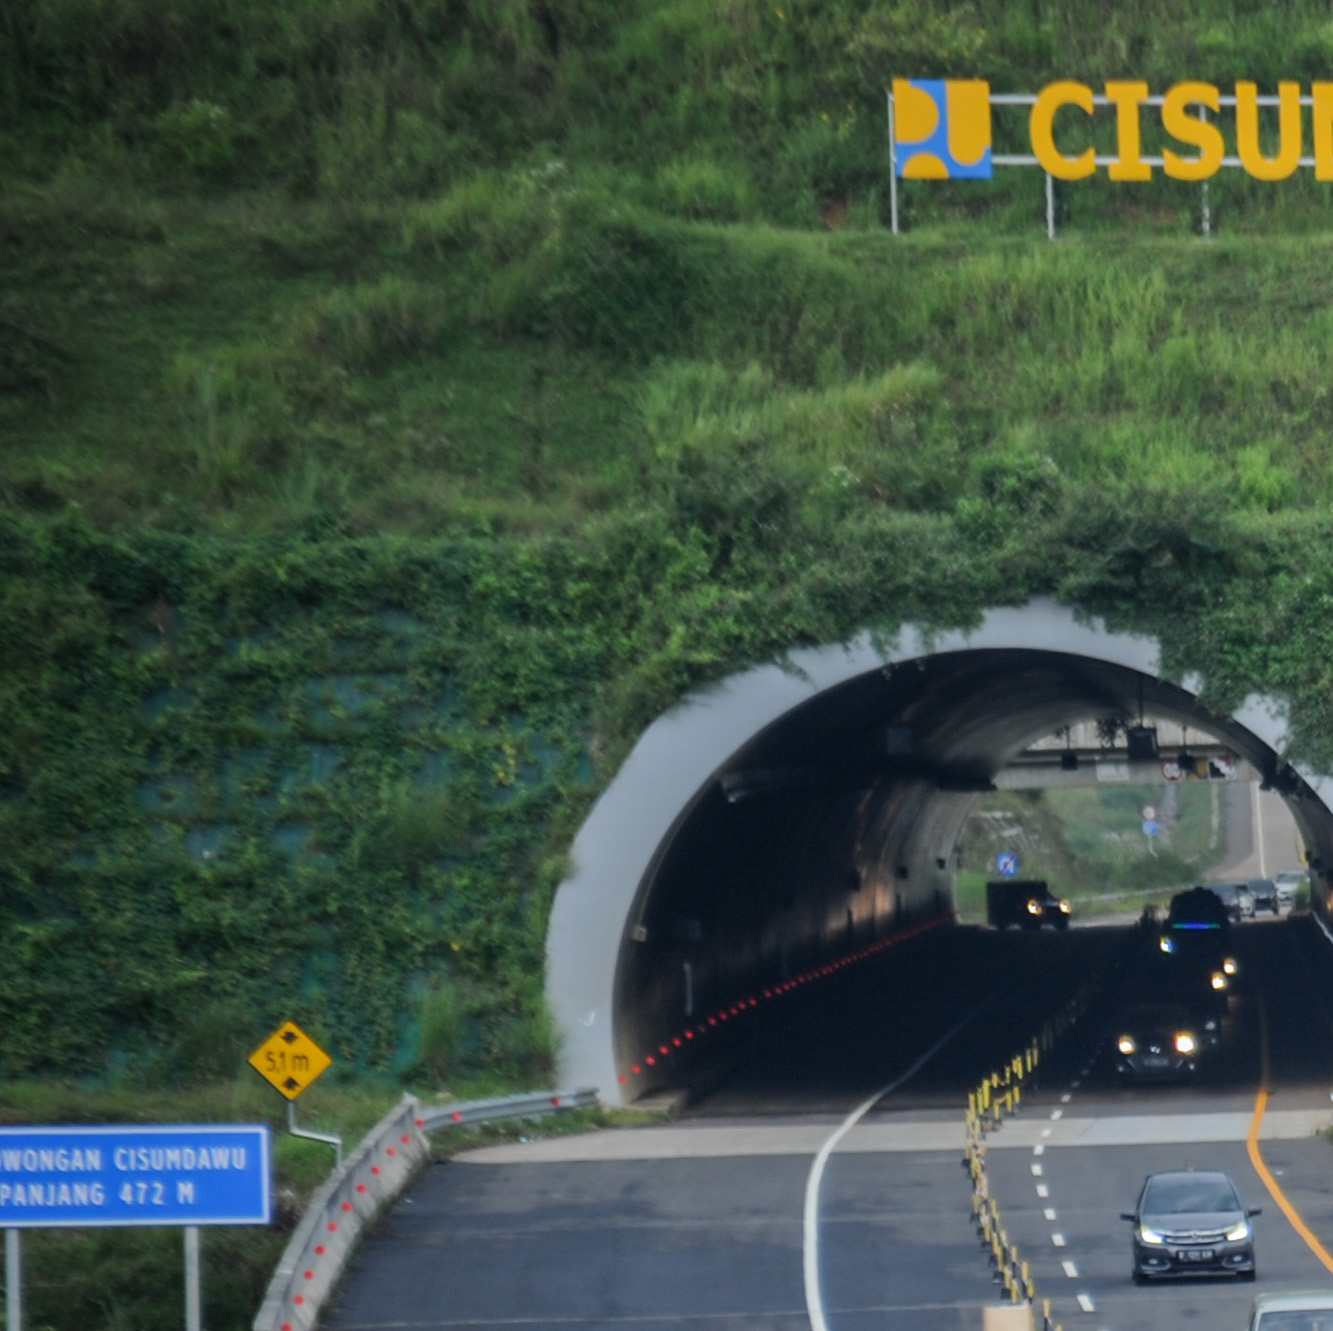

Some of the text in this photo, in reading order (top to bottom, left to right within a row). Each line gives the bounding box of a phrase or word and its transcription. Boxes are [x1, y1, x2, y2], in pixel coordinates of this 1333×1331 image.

[265, 1051, 309, 1074] 5,1 m
[0, 1147, 246, 1172] WONGAN CISUMDAWU
[0, 1181, 195, 1206] PANJANG 472 M
